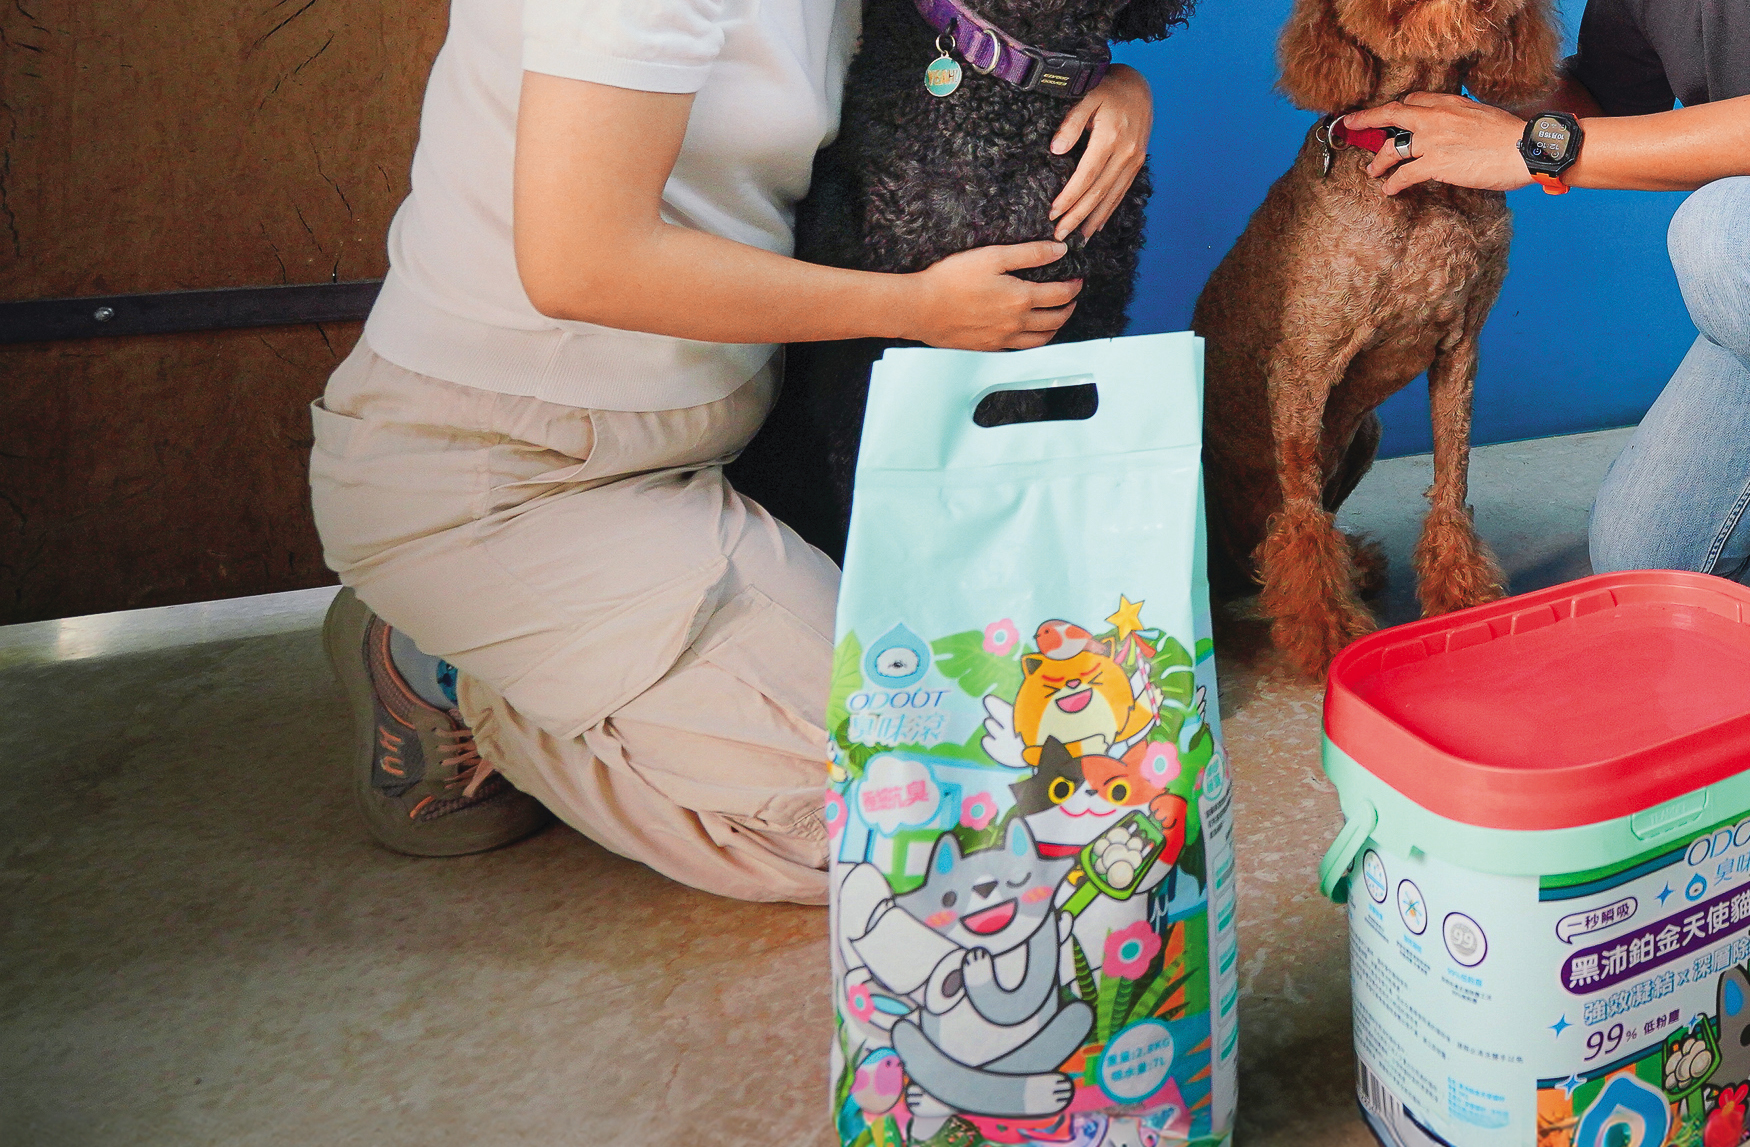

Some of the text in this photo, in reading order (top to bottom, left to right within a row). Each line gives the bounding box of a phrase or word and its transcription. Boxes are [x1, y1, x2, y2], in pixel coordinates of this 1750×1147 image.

[850, 688, 950, 711] ODOUT
[1567, 902, 1630, 931] 一秒瞬吸
[1643, 1008, 1681, 1036] 低粉塵
